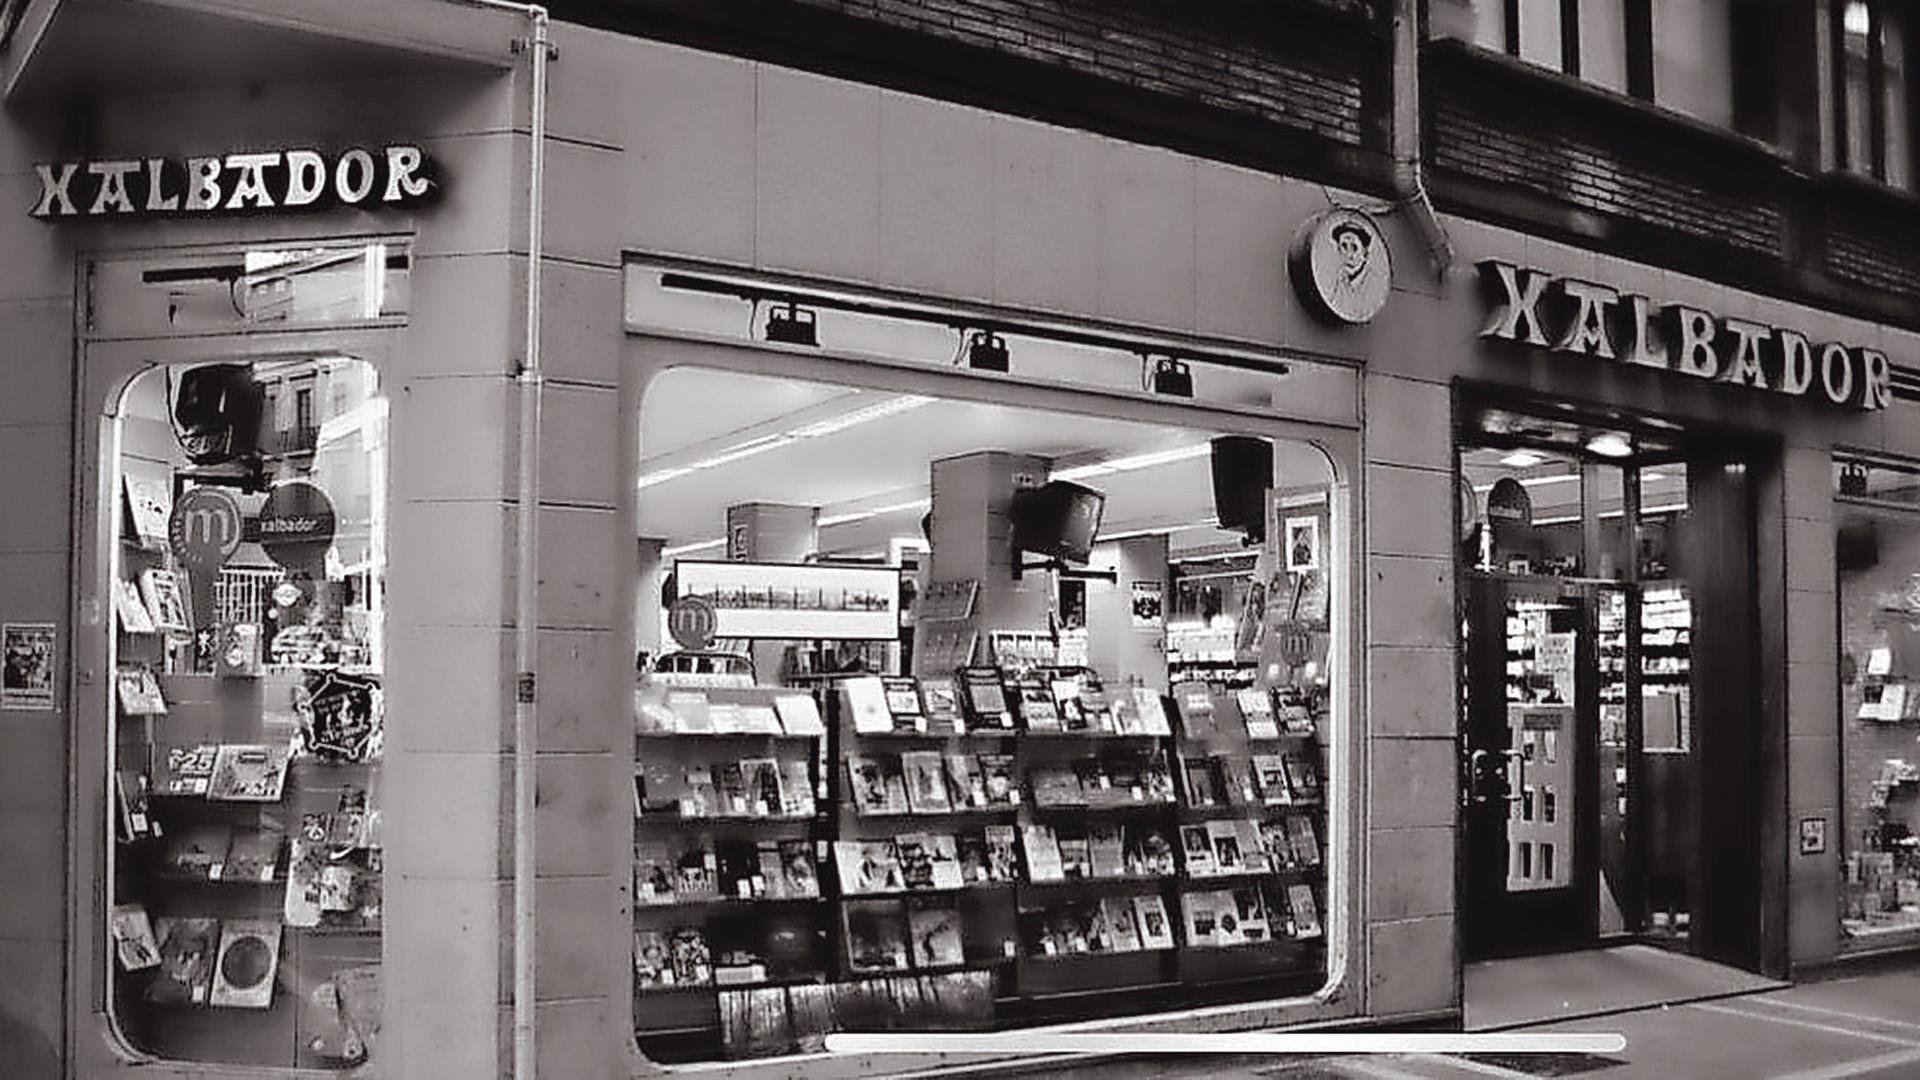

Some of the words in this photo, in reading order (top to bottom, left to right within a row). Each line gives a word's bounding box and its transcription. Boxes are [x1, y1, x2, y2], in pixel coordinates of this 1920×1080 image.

[31, 145, 435, 216] XALBADOR
[1479, 260, 1893, 411] XALBADOR
[260, 516, 318, 533] xalbador
